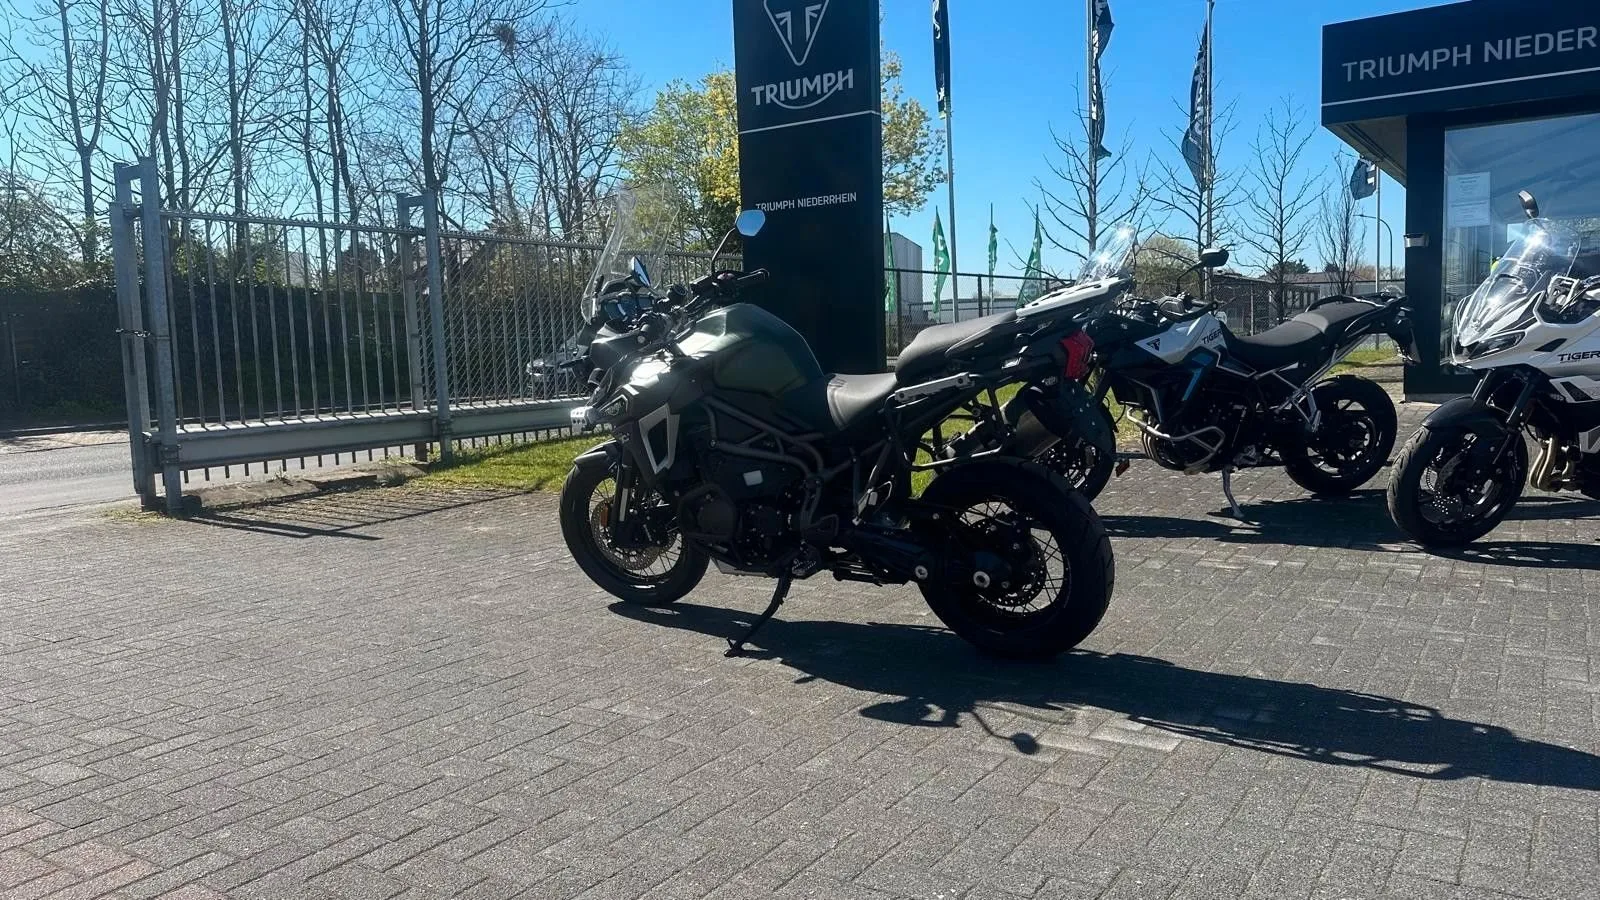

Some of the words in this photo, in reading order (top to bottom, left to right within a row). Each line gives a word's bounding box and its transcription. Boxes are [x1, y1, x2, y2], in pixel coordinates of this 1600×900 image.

[1342, 44, 1472, 82] TRIUMPH
[1483, 26, 1598, 63] NIEDER
[751, 68, 854, 109] TRIUMPH
[797, 192, 857, 208] NIEDERRHEIN
